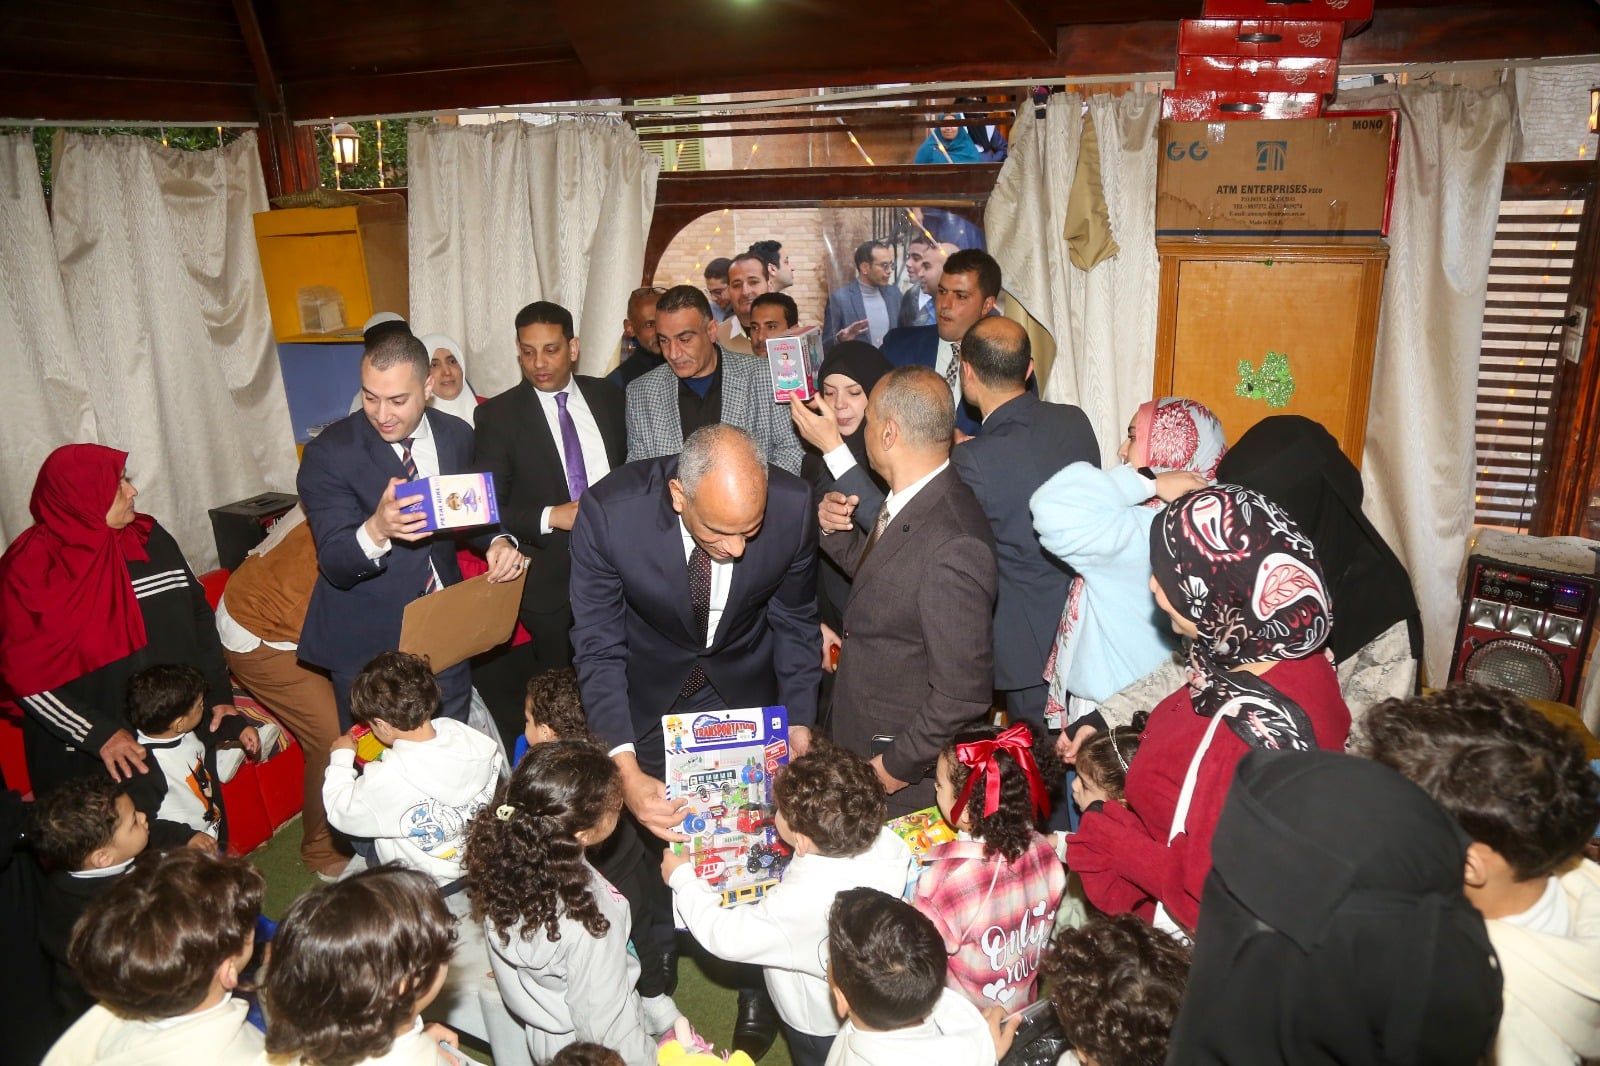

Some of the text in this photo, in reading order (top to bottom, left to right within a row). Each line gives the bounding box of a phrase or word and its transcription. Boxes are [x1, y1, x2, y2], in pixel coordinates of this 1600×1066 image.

[1352, 119, 1383, 130] MONO
[1216, 184, 1237, 194] ATM
[1240, 184, 1308, 194] ENTERPRISES
[981, 908, 1045, 971] Only
